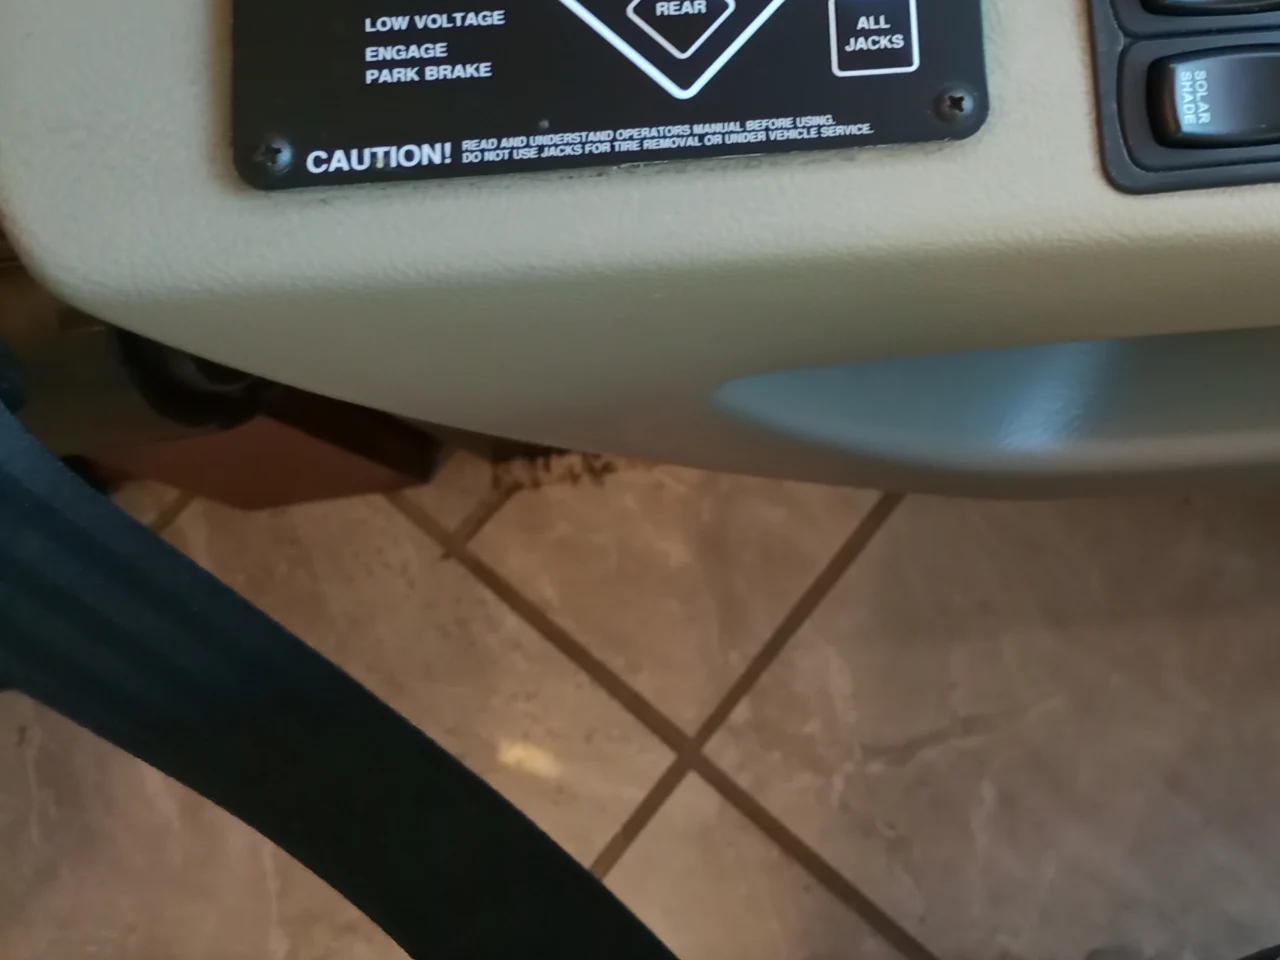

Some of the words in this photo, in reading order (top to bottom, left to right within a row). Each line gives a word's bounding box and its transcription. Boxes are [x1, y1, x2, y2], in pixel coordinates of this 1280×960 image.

[656, 0, 707, 16] REAR
[365, 16, 410, 32] LOW
[414, 10, 505, 30] VOLTAGE
[856, 15, 891, 30] ALL
[365, 43, 448, 62] ENGAGE
[845, 34, 904, 52] JACKS
[366, 67, 420, 84] PARK
[424, 62, 492, 81] BRAKE
[1180, 71, 1197, 125] SHADE
[1194, 71, 1211, 124] SOLAR
[462, 138, 498, 151] READ
[500, 137, 527, 149] AND
[529, 130, 614, 147] UNDERSTAND
[617, 124, 691, 140] OPERATORS
[693, 121, 743, 136] MANUAL
[746, 118, 794, 131] BEFORE
[796, 114, 836, 128] USING.
[463, 152, 480, 164] DO
[484, 150, 508, 162] NOT
[511, 148, 539, 161] USE
[541, 145, 581, 159] JACKS
[584, 142, 611, 155] FOR
[613, 140, 641, 152] TIRE
[643, 136, 702, 150] REMOVAL
[704, 134, 723, 146] OR
[724, 131, 767, 144] UNDER
[768, 127, 819, 141] VEHICLE
[820, 123, 874, 137] SERVICE.
[306, 142, 452, 174] CAUTION!
